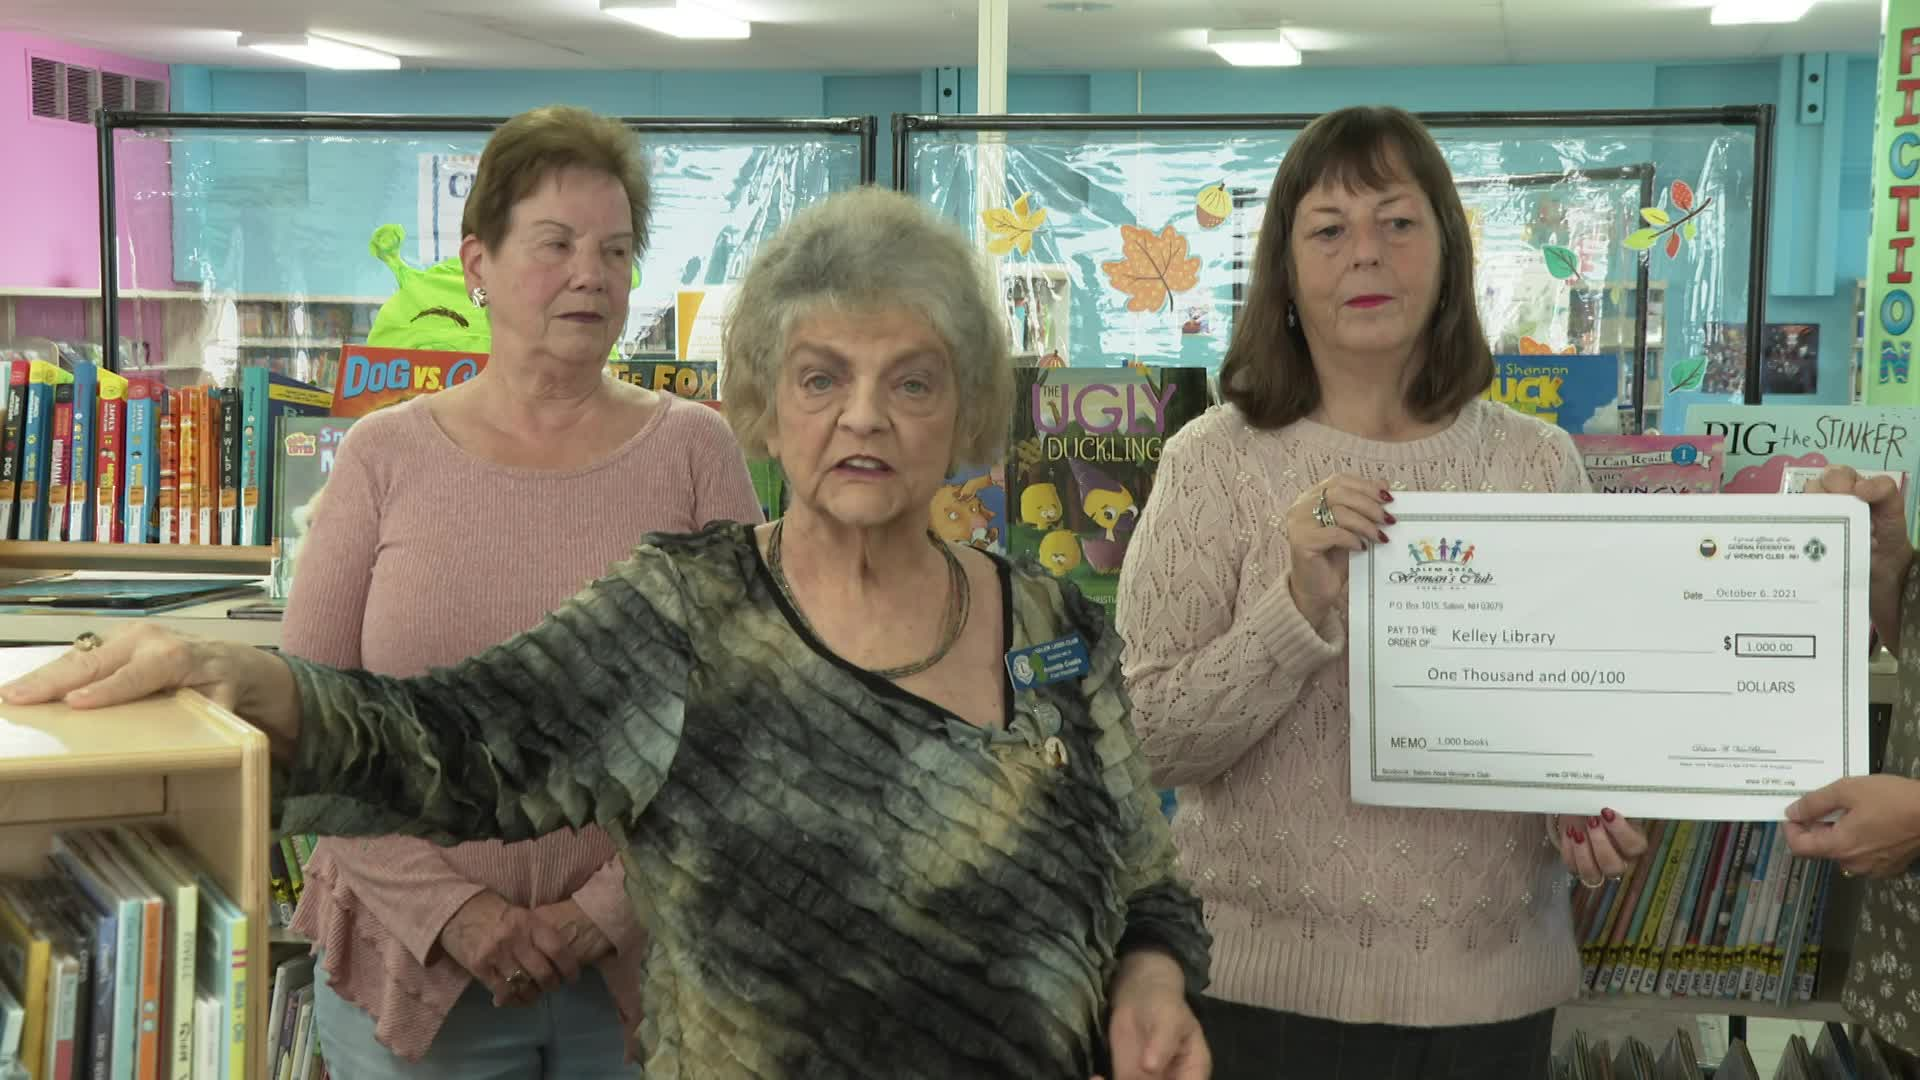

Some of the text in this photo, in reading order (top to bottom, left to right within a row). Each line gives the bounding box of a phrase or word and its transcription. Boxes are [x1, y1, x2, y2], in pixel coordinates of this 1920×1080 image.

[1880, 27, 1920, 385] FICTION
[1506, 363, 1569, 376] Shannon
[653, 364, 718, 400] FOX
[1031, 383, 1177, 433] THE UGLY
[1047, 436, 1163, 462] DUCKLING
[1782, 425, 1811, 449] the
[1814, 415, 1908, 470] STINKER
[1603, 457, 1628, 466] Can
[1632, 453, 1666, 464] Read!
[1683, 591, 1703, 600] Date
[1716, 588, 1756, 598] October
[1773, 588, 1797, 598] 2021
[1387, 625, 1437, 635] PAY TO THE
[1452, 628, 1556, 646] Kelley Library
[1387, 638, 1431, 648] ORDER OF
[1723, 635, 1732, 651] $
[1427, 666, 1625, 685] One Thousand and 00/100
[1737, 680, 1796, 694] DOLLARS
[1391, 737, 1427, 749] MEMO
[1463, 738, 1489, 747] books
